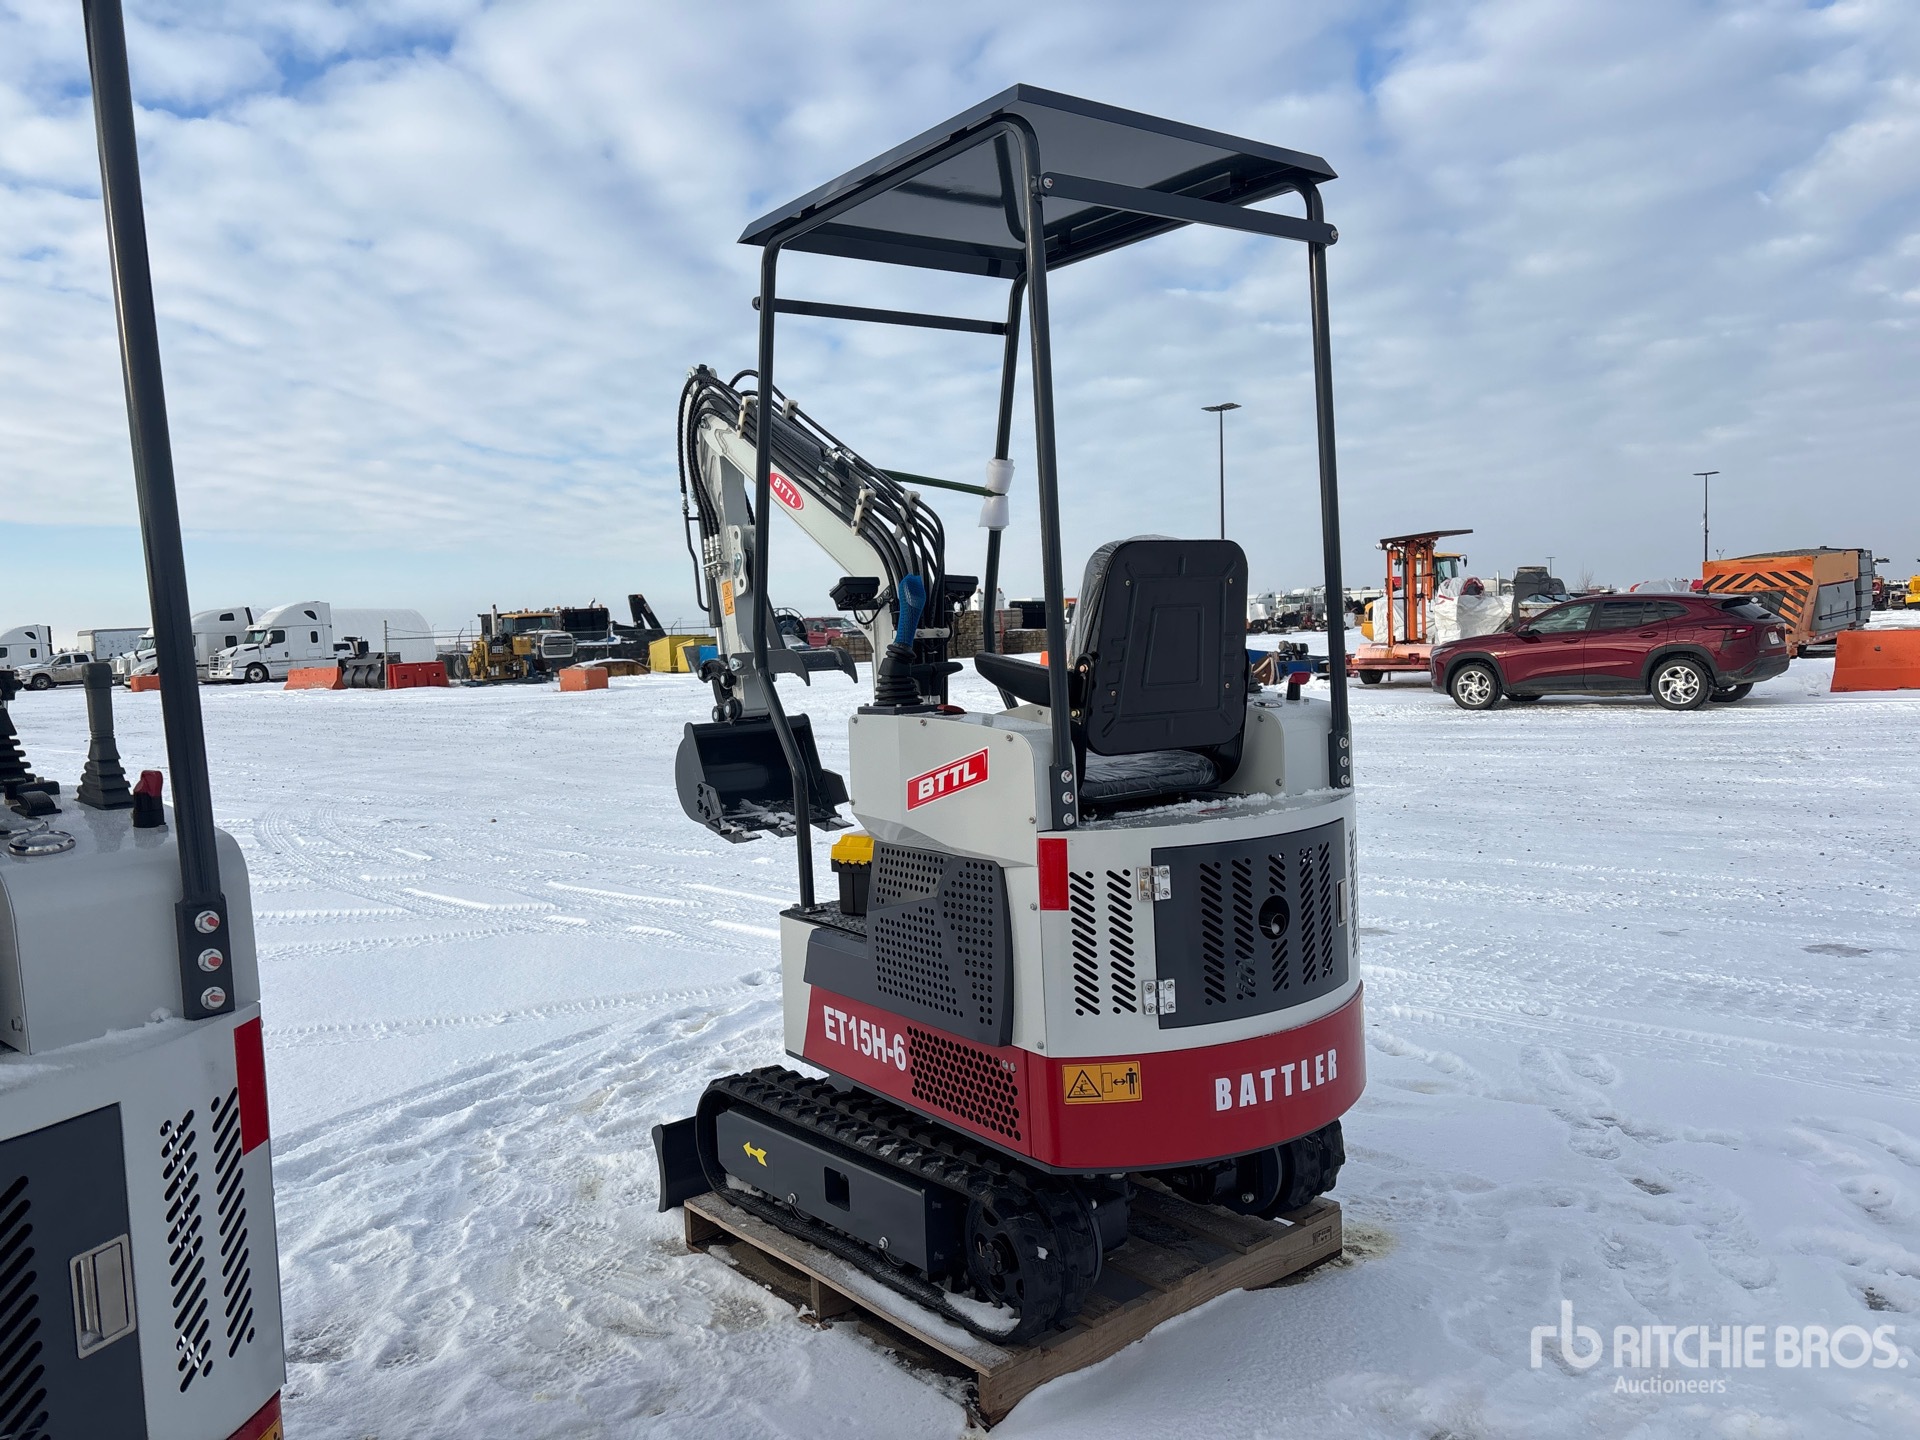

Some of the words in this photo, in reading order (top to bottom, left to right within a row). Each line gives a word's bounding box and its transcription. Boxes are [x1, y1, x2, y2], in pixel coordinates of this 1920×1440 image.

[773, 477, 797, 507] BTTL
[918, 761, 978, 800] BTTL
[823, 1004, 907, 1072] ET15H-6
[1214, 1048, 1338, 1112] BATTLER
